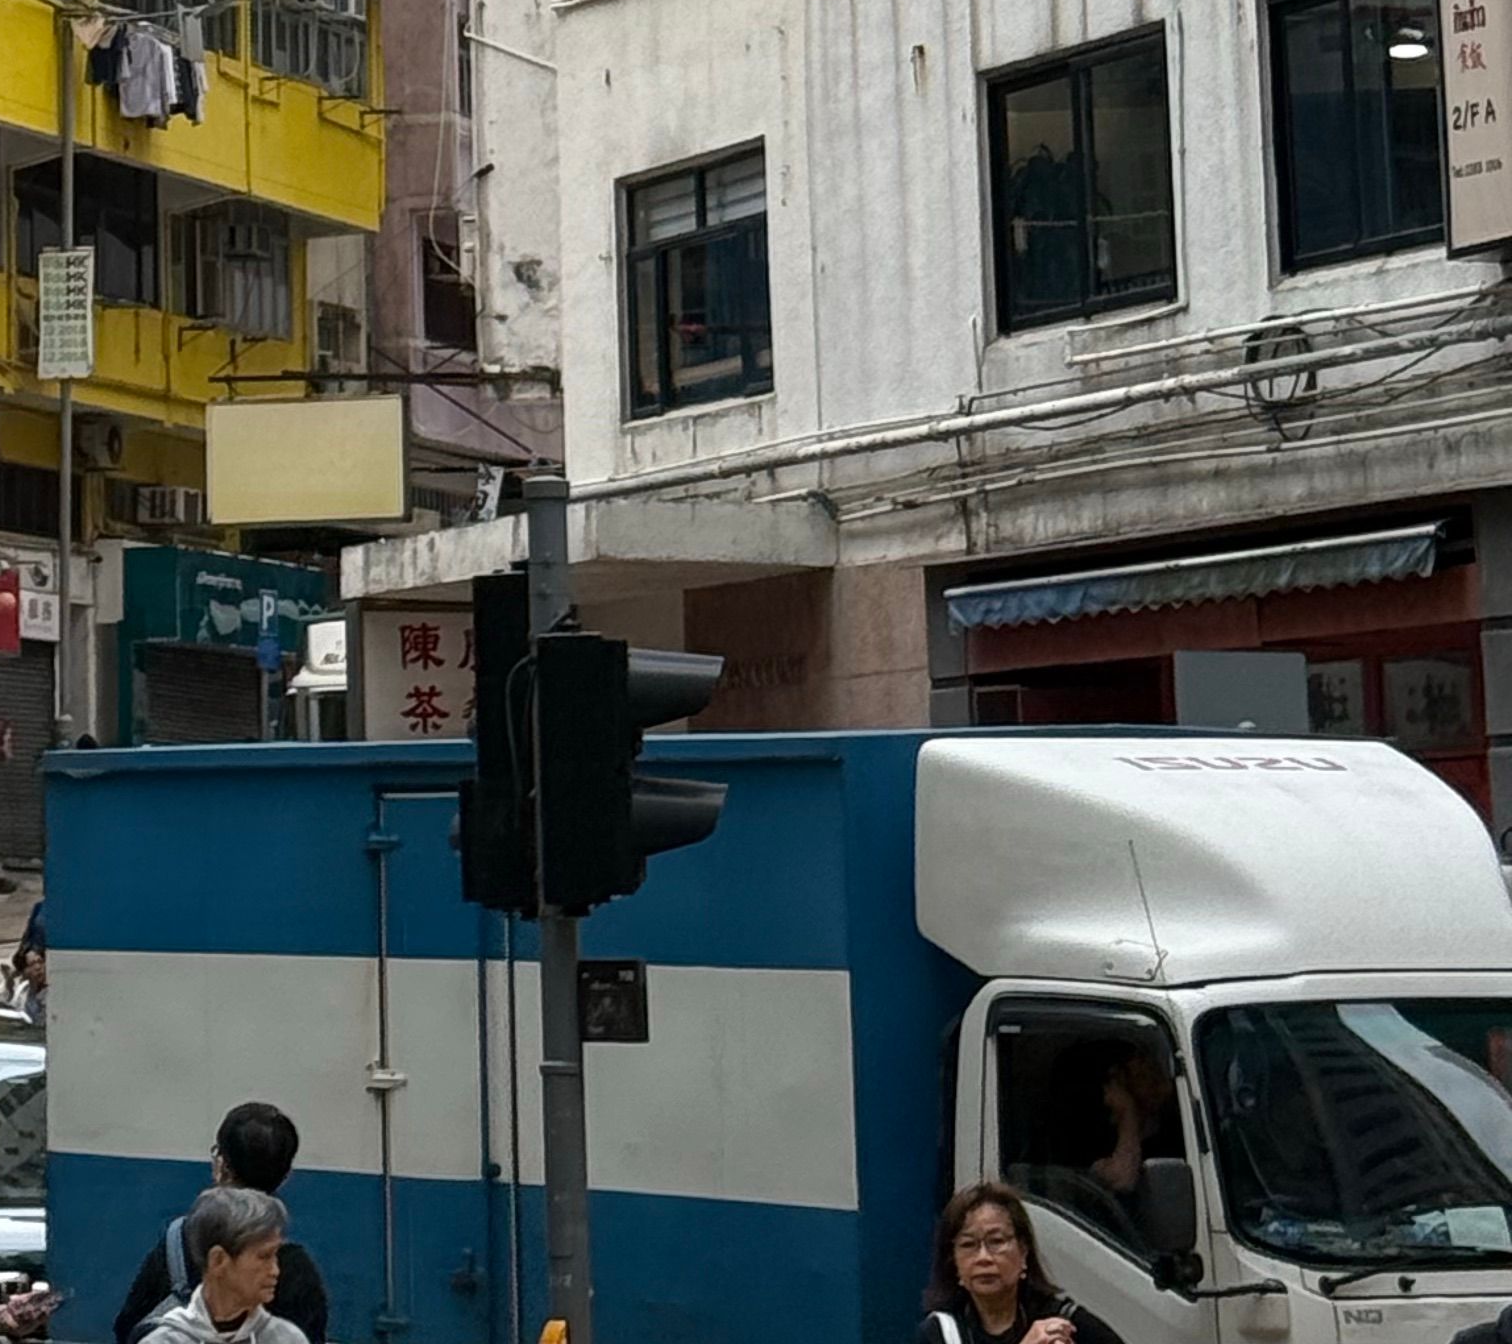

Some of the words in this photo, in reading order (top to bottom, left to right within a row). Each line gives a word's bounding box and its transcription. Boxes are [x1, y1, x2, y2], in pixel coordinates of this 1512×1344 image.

[1452, 100, 1480, 131] 2/F
[1484, 98, 1496, 124] A
[262, 593, 276, 631] P
[1113, 756, 1348, 772] ISUZU
